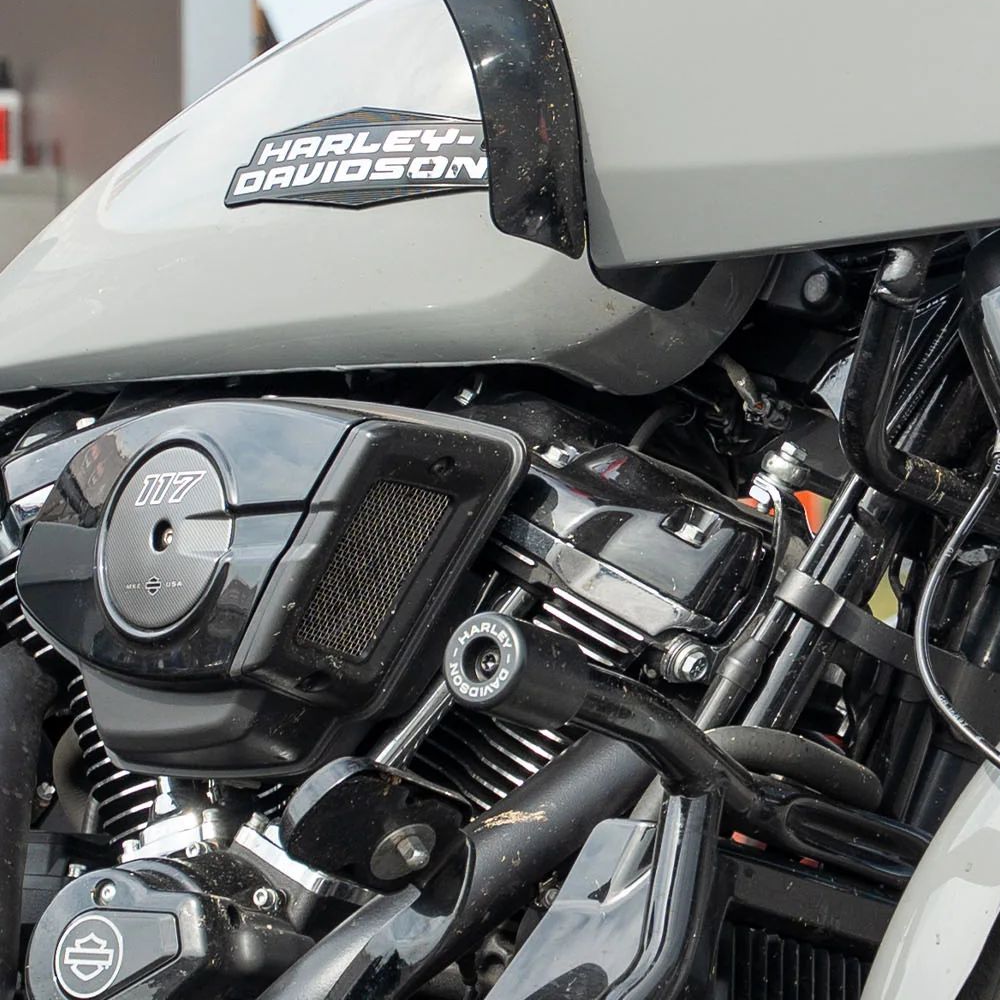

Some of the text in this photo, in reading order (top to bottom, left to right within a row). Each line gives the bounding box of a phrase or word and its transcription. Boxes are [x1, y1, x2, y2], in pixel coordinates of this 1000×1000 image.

[257, 128, 475, 166] HARLEY-
[233, 155, 488, 196] DAVIDSON
[135, 470, 207, 507] 117
[458, 622, 512, 646] HARLEY
[449, 662, 509, 697] DAVIDSON
